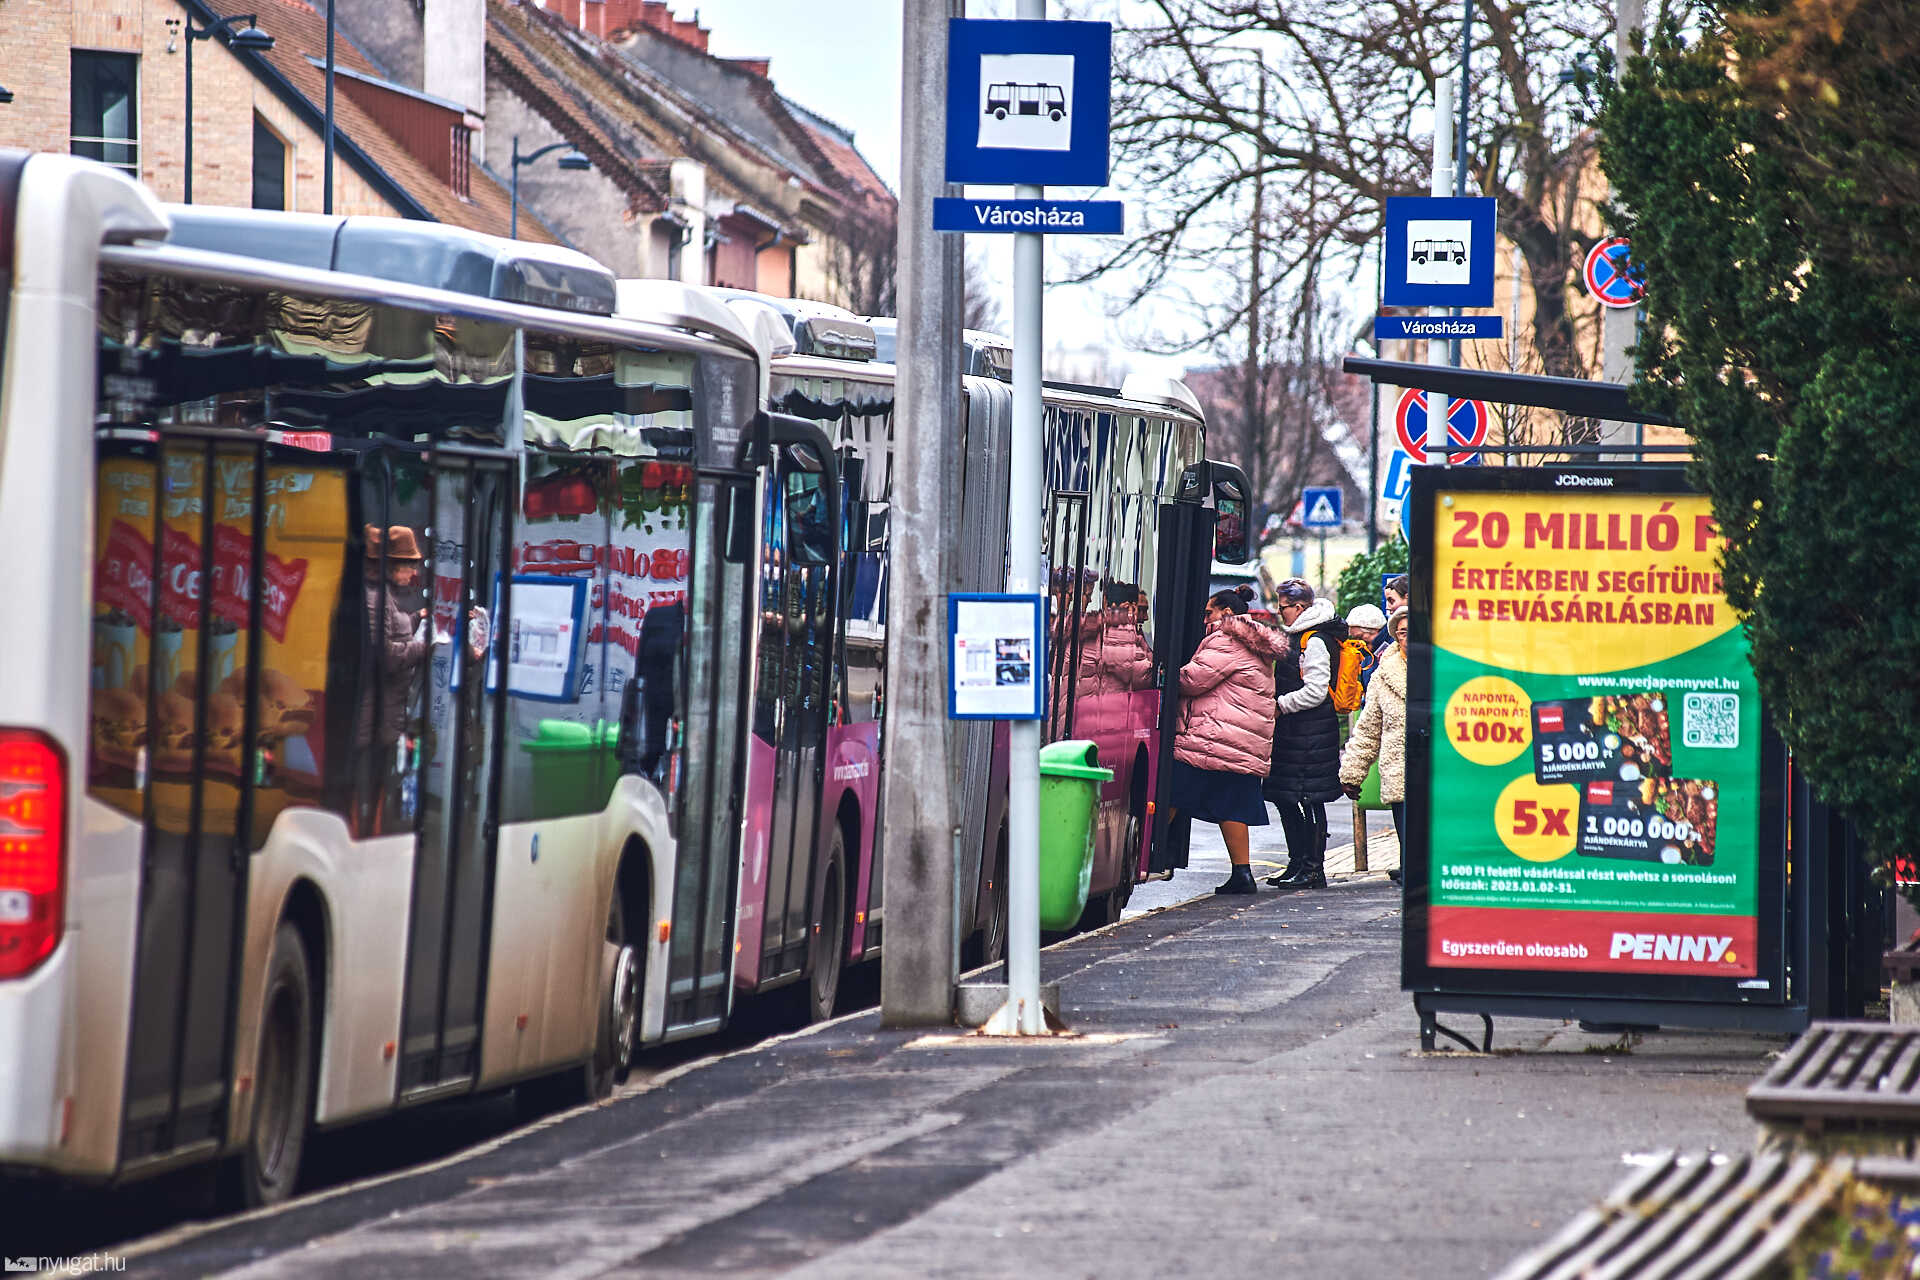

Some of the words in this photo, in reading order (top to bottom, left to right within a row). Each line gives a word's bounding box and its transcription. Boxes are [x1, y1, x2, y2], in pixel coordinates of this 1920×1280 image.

[974, 205, 1085, 226] Városháza
[1401, 320, 1476, 334] Városháza
[1555, 474, 1614, 487] JCDecaux
[1452, 511, 1510, 549] 20
[1524, 501, 1680, 552] MILLIÓ
[1451, 561, 1589, 592] ÉRTÉKBEN
[1450, 599, 1470, 620] A
[1478, 594, 1715, 625] BEVÁSÁRLÁSBAN
[1577, 675, 1740, 691] www.nyerjapennyvel.hu
[1463, 693, 1519, 705] NAPONTA,
[1453, 706, 1467, 716] 30
[1470, 707, 1510, 718] NAPON
[1512, 705, 1529, 718] ÁT:
[1456, 721, 1525, 744] 100x
[1541, 743, 1555, 762] 5
[1559, 741, 1599, 761] 000
[1603, 749, 1613, 759] Ft
[1543, 761, 1606, 773] AJÁNDÉKKÁRTYA
[1513, 800, 1571, 836] 5x
[1586, 815, 1599, 834] 1
[1604, 816, 1644, 838] 000
[1648, 821, 1689, 841] 000
[1584, 835, 1648, 849] AJÁNDÉKKÁRTYA
[1441, 866, 1449, 876] 5
[1451, 866, 1473, 877] 000
[1475, 867, 1485, 877] Ft
[1487, 867, 1522, 878] feletti
[1523, 867, 1585, 880] vásárlással
[1586, 869, 1615, 881] részt
[1616, 871, 1660, 882] vehetsz
[1662, 874, 1669, 882] a
[1671, 872, 1737, 884] sorsoláson!
[1441, 878, 1489, 891] Időszak:
[1490, 880, 1577, 894] 2023.01.02-31.
[1442, 939, 1523, 957] Egyszerűen
[1526, 942, 1588, 958] okosabb
